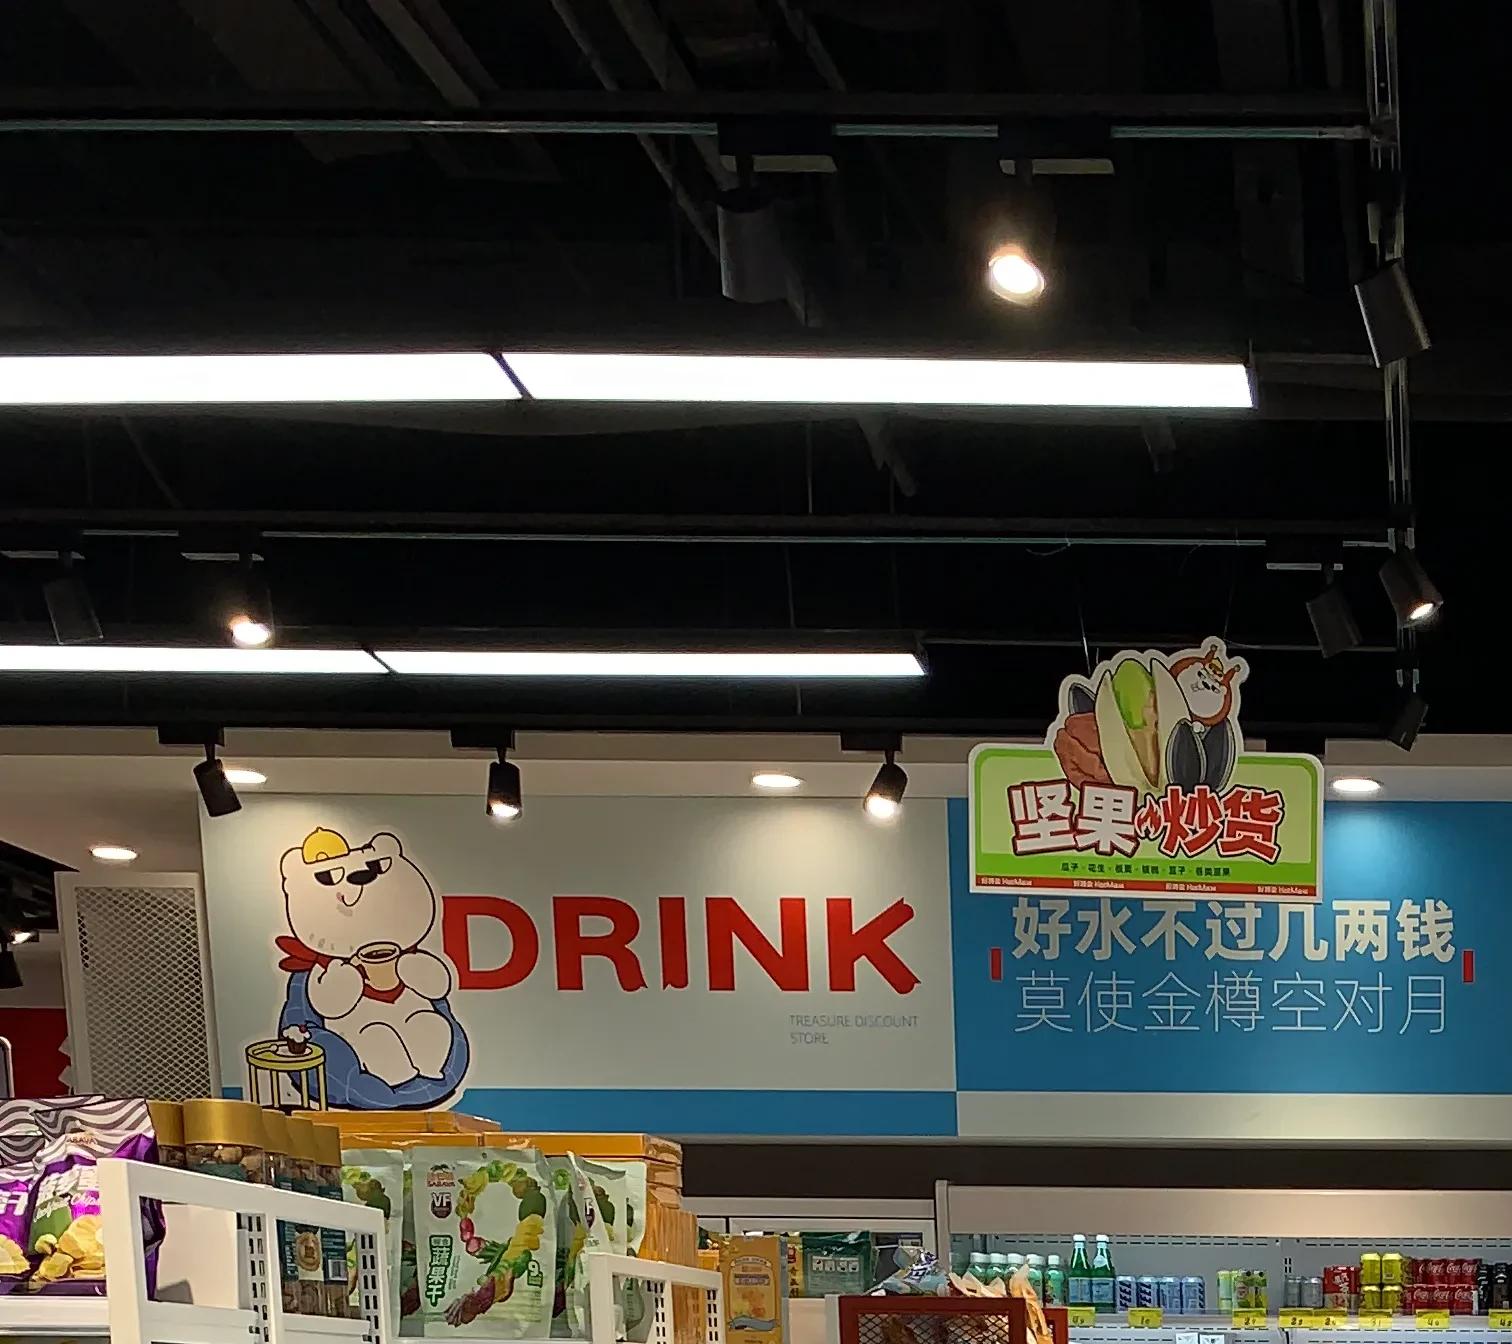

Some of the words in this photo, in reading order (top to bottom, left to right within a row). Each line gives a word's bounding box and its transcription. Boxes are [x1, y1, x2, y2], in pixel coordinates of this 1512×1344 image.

[442, 894, 922, 994] DRINK
[1011, 897, 1457, 963] 好水不过几两钱
[789, 1014, 850, 1028] TREASURE
[855, 1014, 918, 1028] DISCOUNT
[1014, 970, 1448, 1036] 莫使金樽空对月
[790, 1031, 829, 1045] STORE
[426, 1248, 450, 1305] 蔬果干
